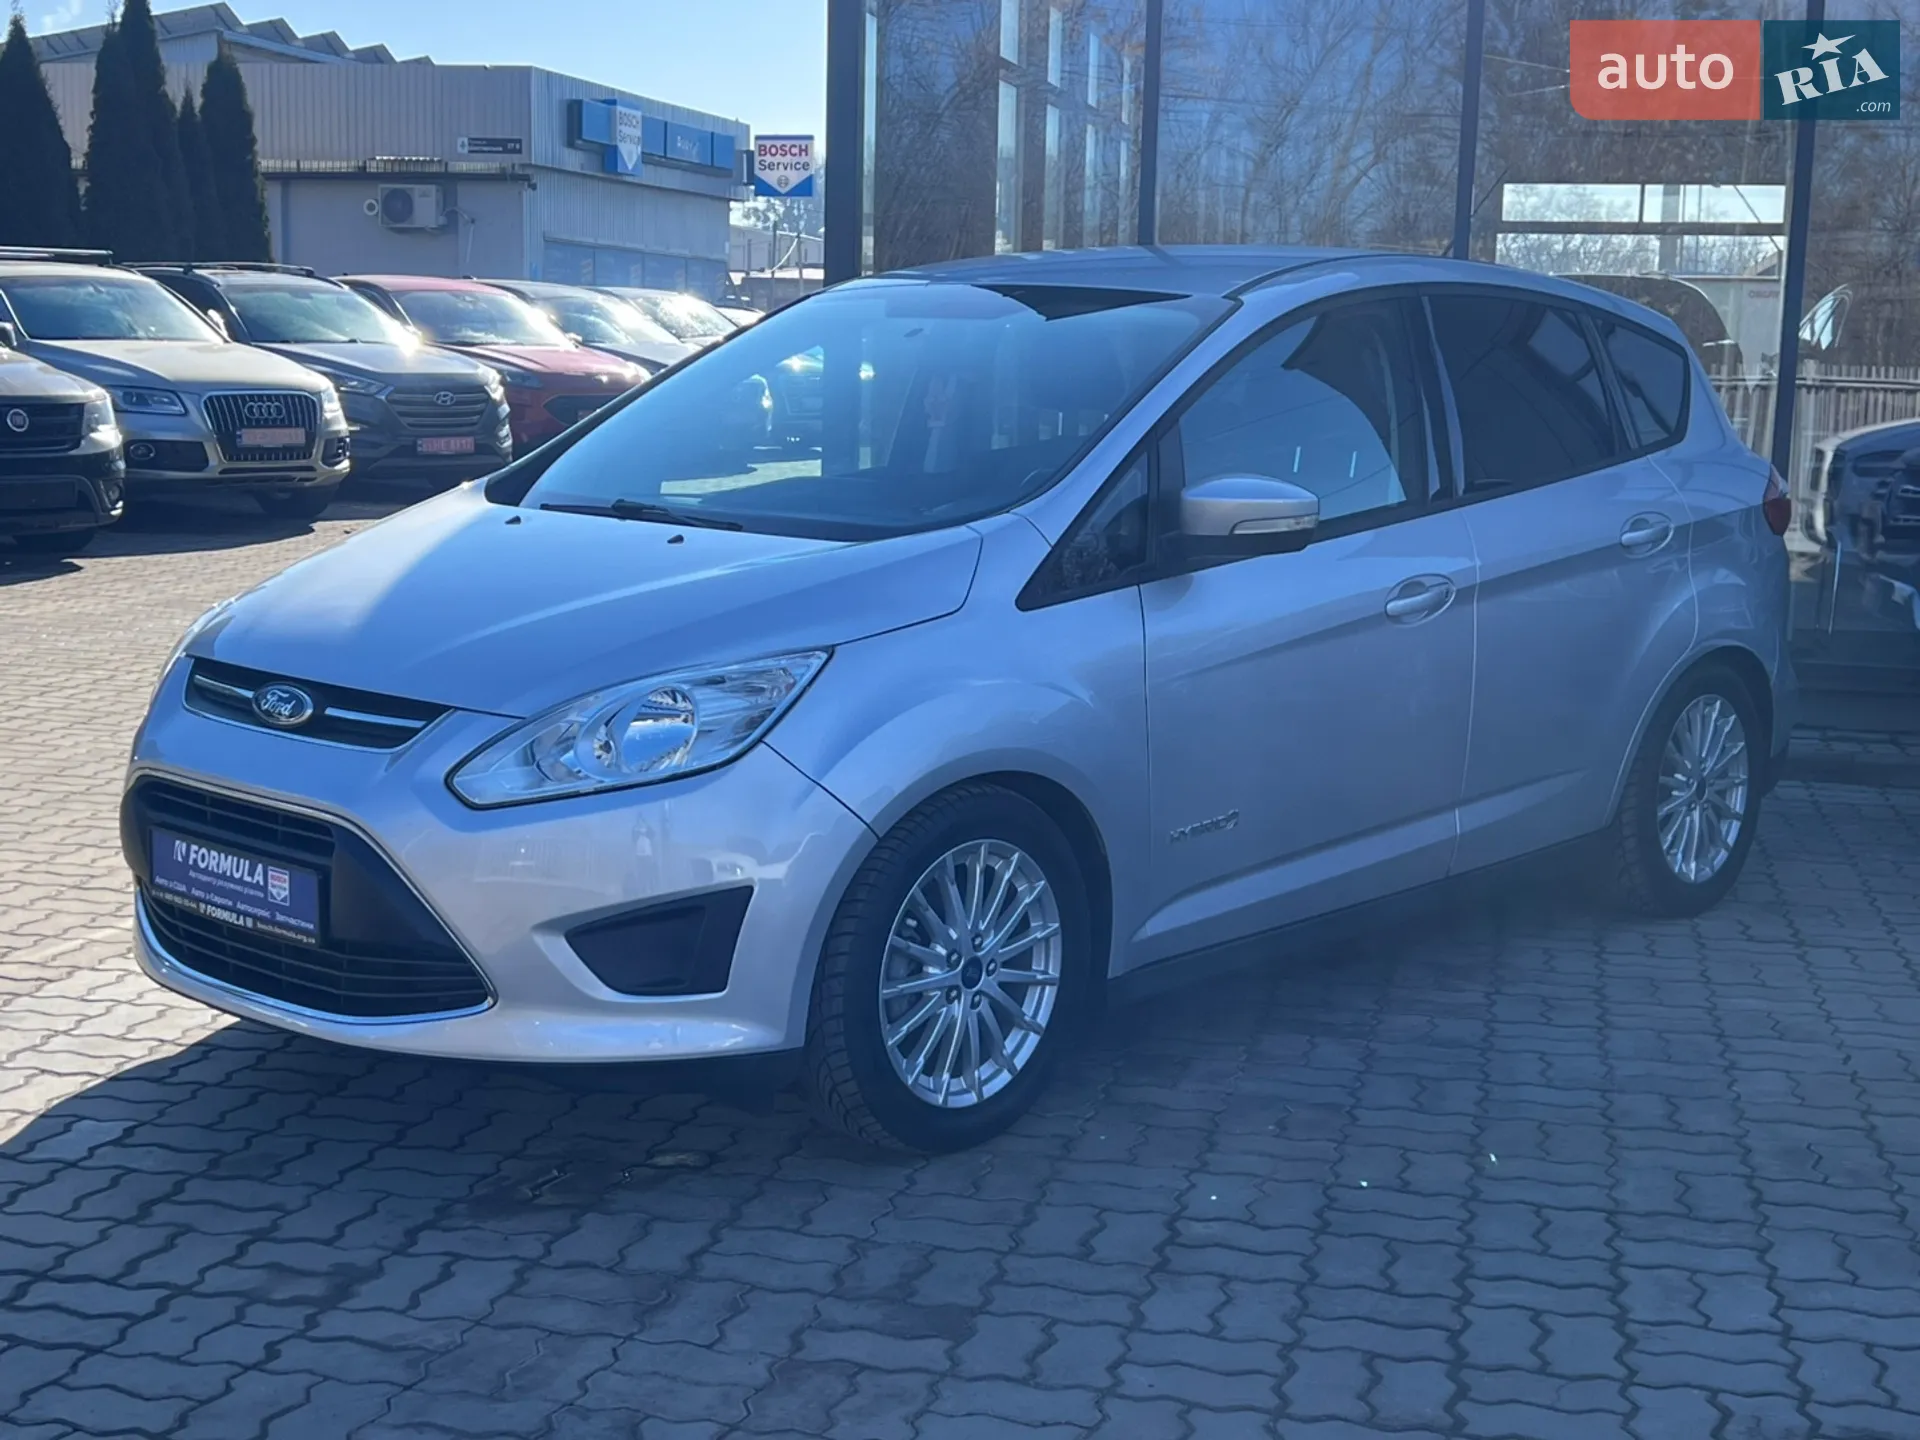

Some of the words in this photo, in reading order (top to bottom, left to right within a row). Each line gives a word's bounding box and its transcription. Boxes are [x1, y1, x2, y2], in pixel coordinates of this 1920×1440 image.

[618, 110, 640, 128] BOSCH
[757, 143, 809, 158] BOSCH
[757, 158, 811, 172] Service
[260, 689, 297, 717] Ford
[188, 844, 264, 886] FORMULA
[206, 904, 245, 927] FORMULA
